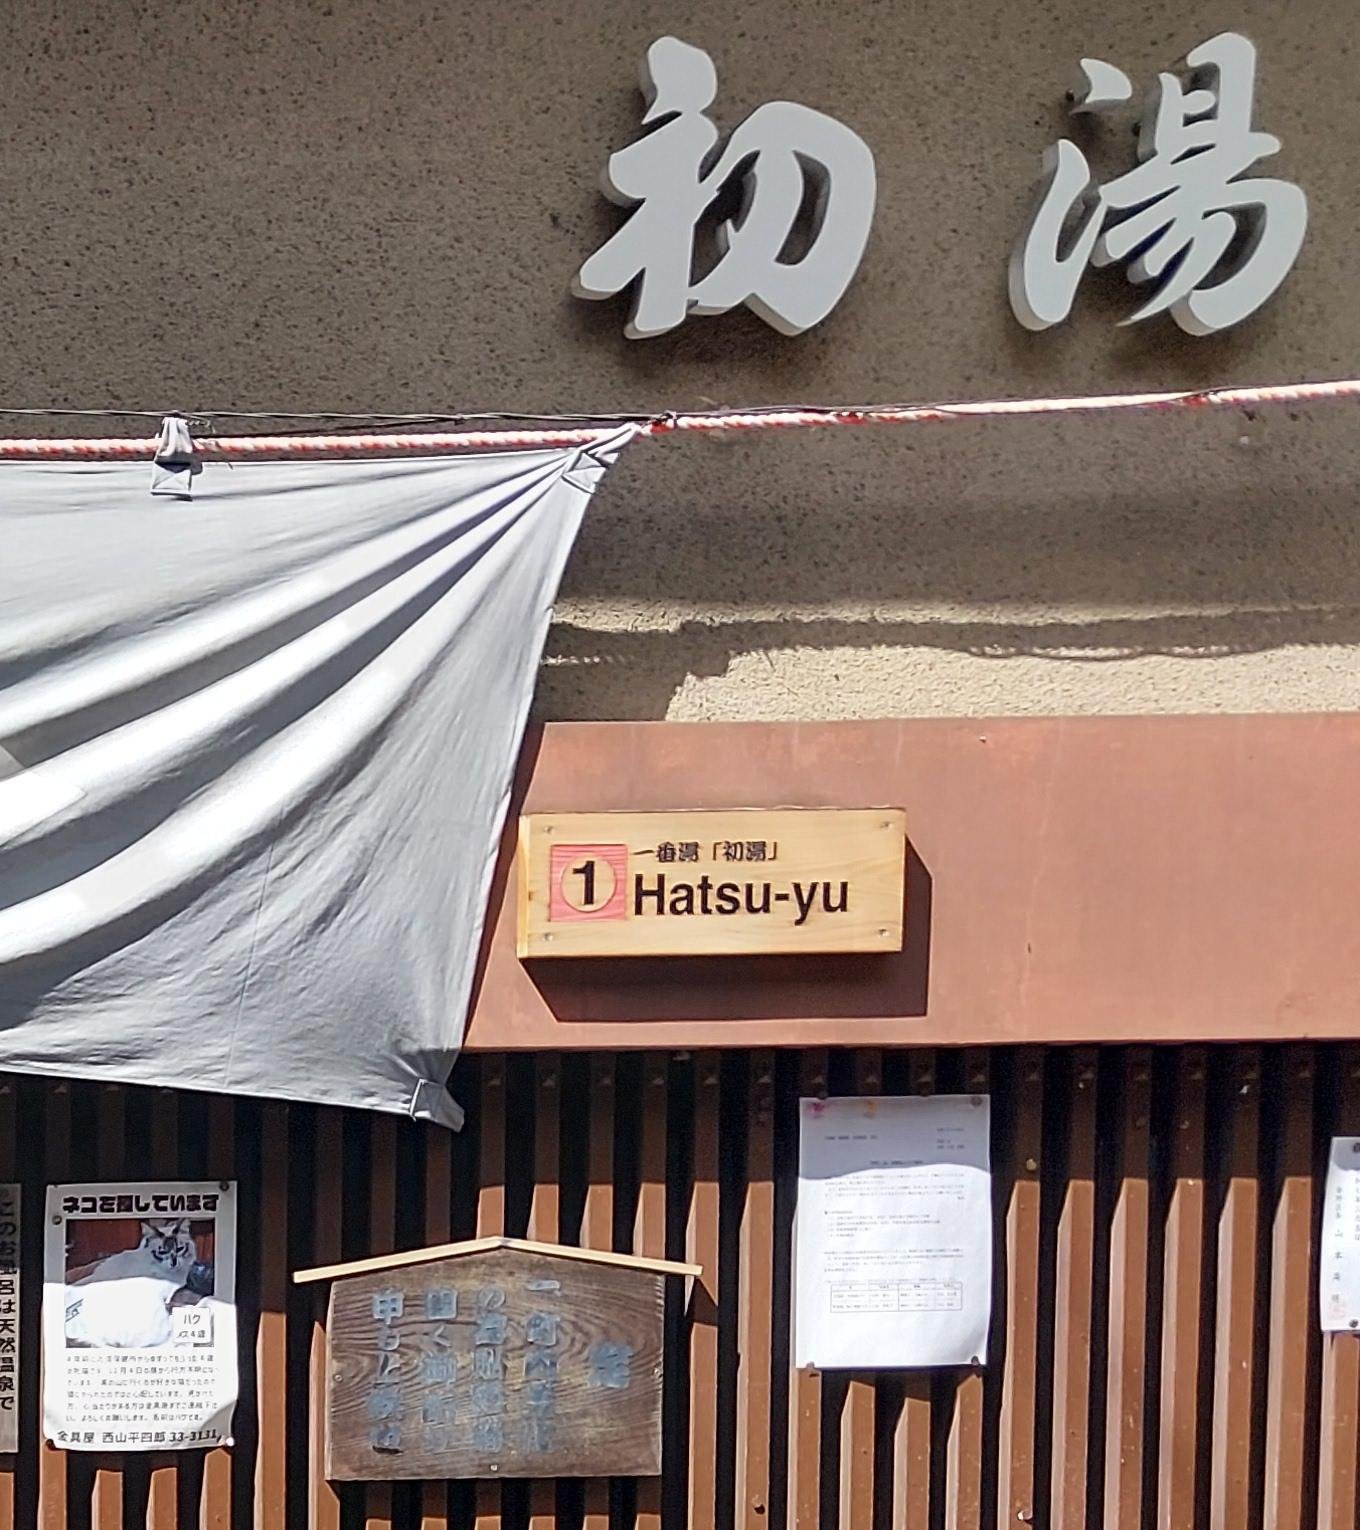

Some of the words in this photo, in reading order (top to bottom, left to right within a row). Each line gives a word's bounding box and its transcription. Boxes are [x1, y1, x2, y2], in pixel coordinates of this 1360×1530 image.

[571, 31, 1308, 338] 初湯
[633, 840, 779, 863] 一番湯「初湯」
[572, 859, 597, 906] 1
[634, 872, 849, 926] Hatsu-yu
